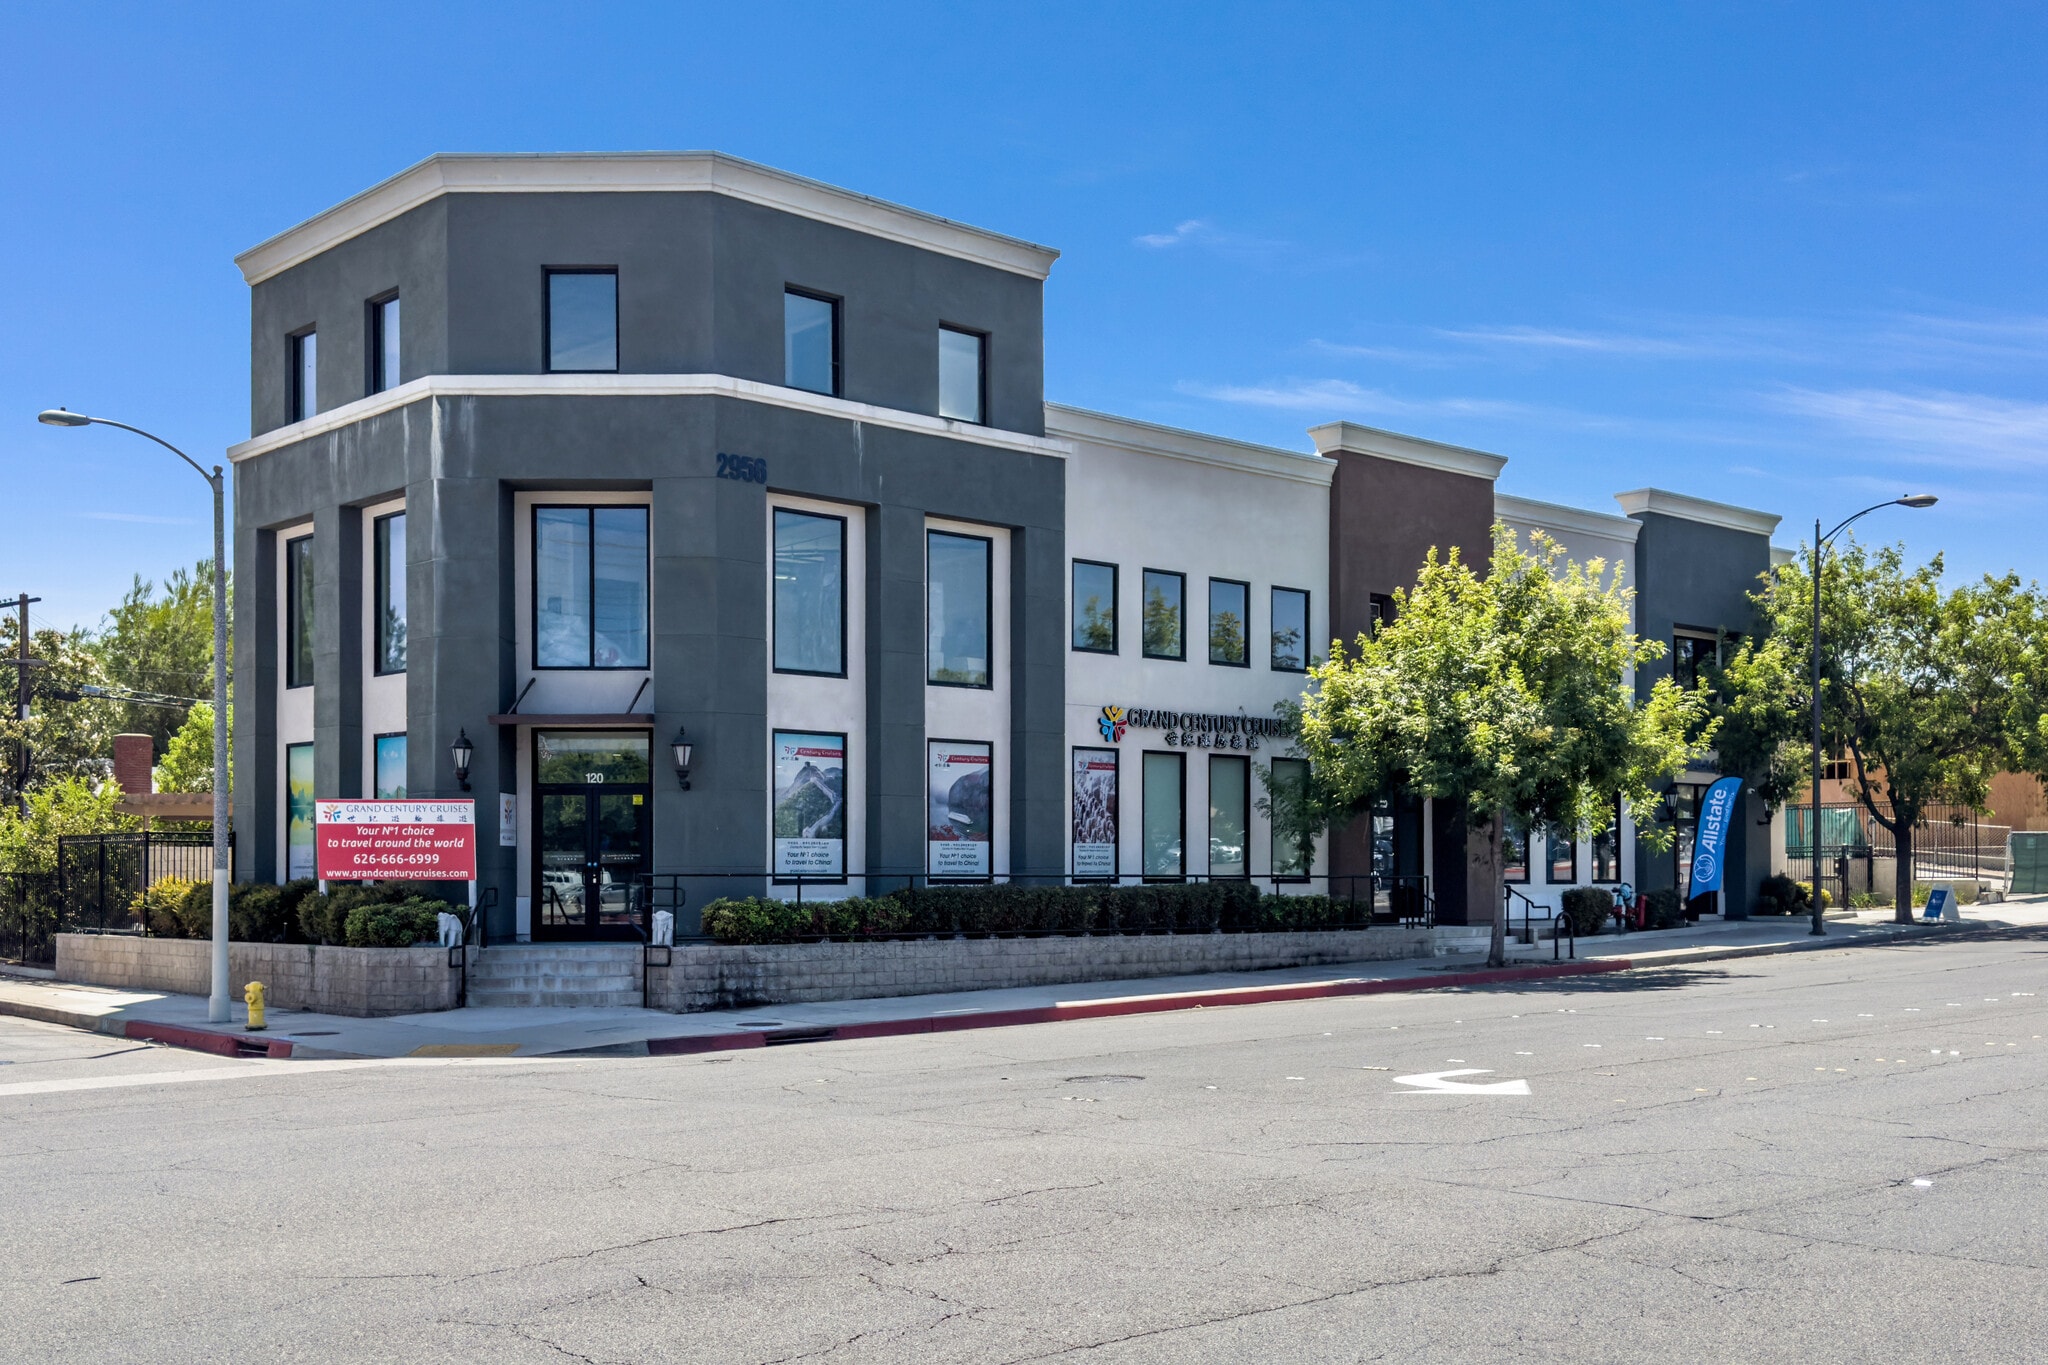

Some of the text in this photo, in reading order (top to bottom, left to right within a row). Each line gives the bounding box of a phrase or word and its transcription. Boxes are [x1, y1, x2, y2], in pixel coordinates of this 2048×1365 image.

[1127, 708, 1180, 731] GRAND
[1180, 712, 1242, 734] CENTURY
[585, 772, 604, 784] 120
[346, 804, 469, 813] GRAND CENTURY CRUISES
[1701, 789, 1727, 854] Allstate
[356, 826, 380, 836] Your
[402, 826, 435, 836] choice
[327, 838, 465, 848] to travel around the world
[353, 853, 440, 865] 626-666-6999
[326, 868, 469, 880] www.grandcenturycruises.com
